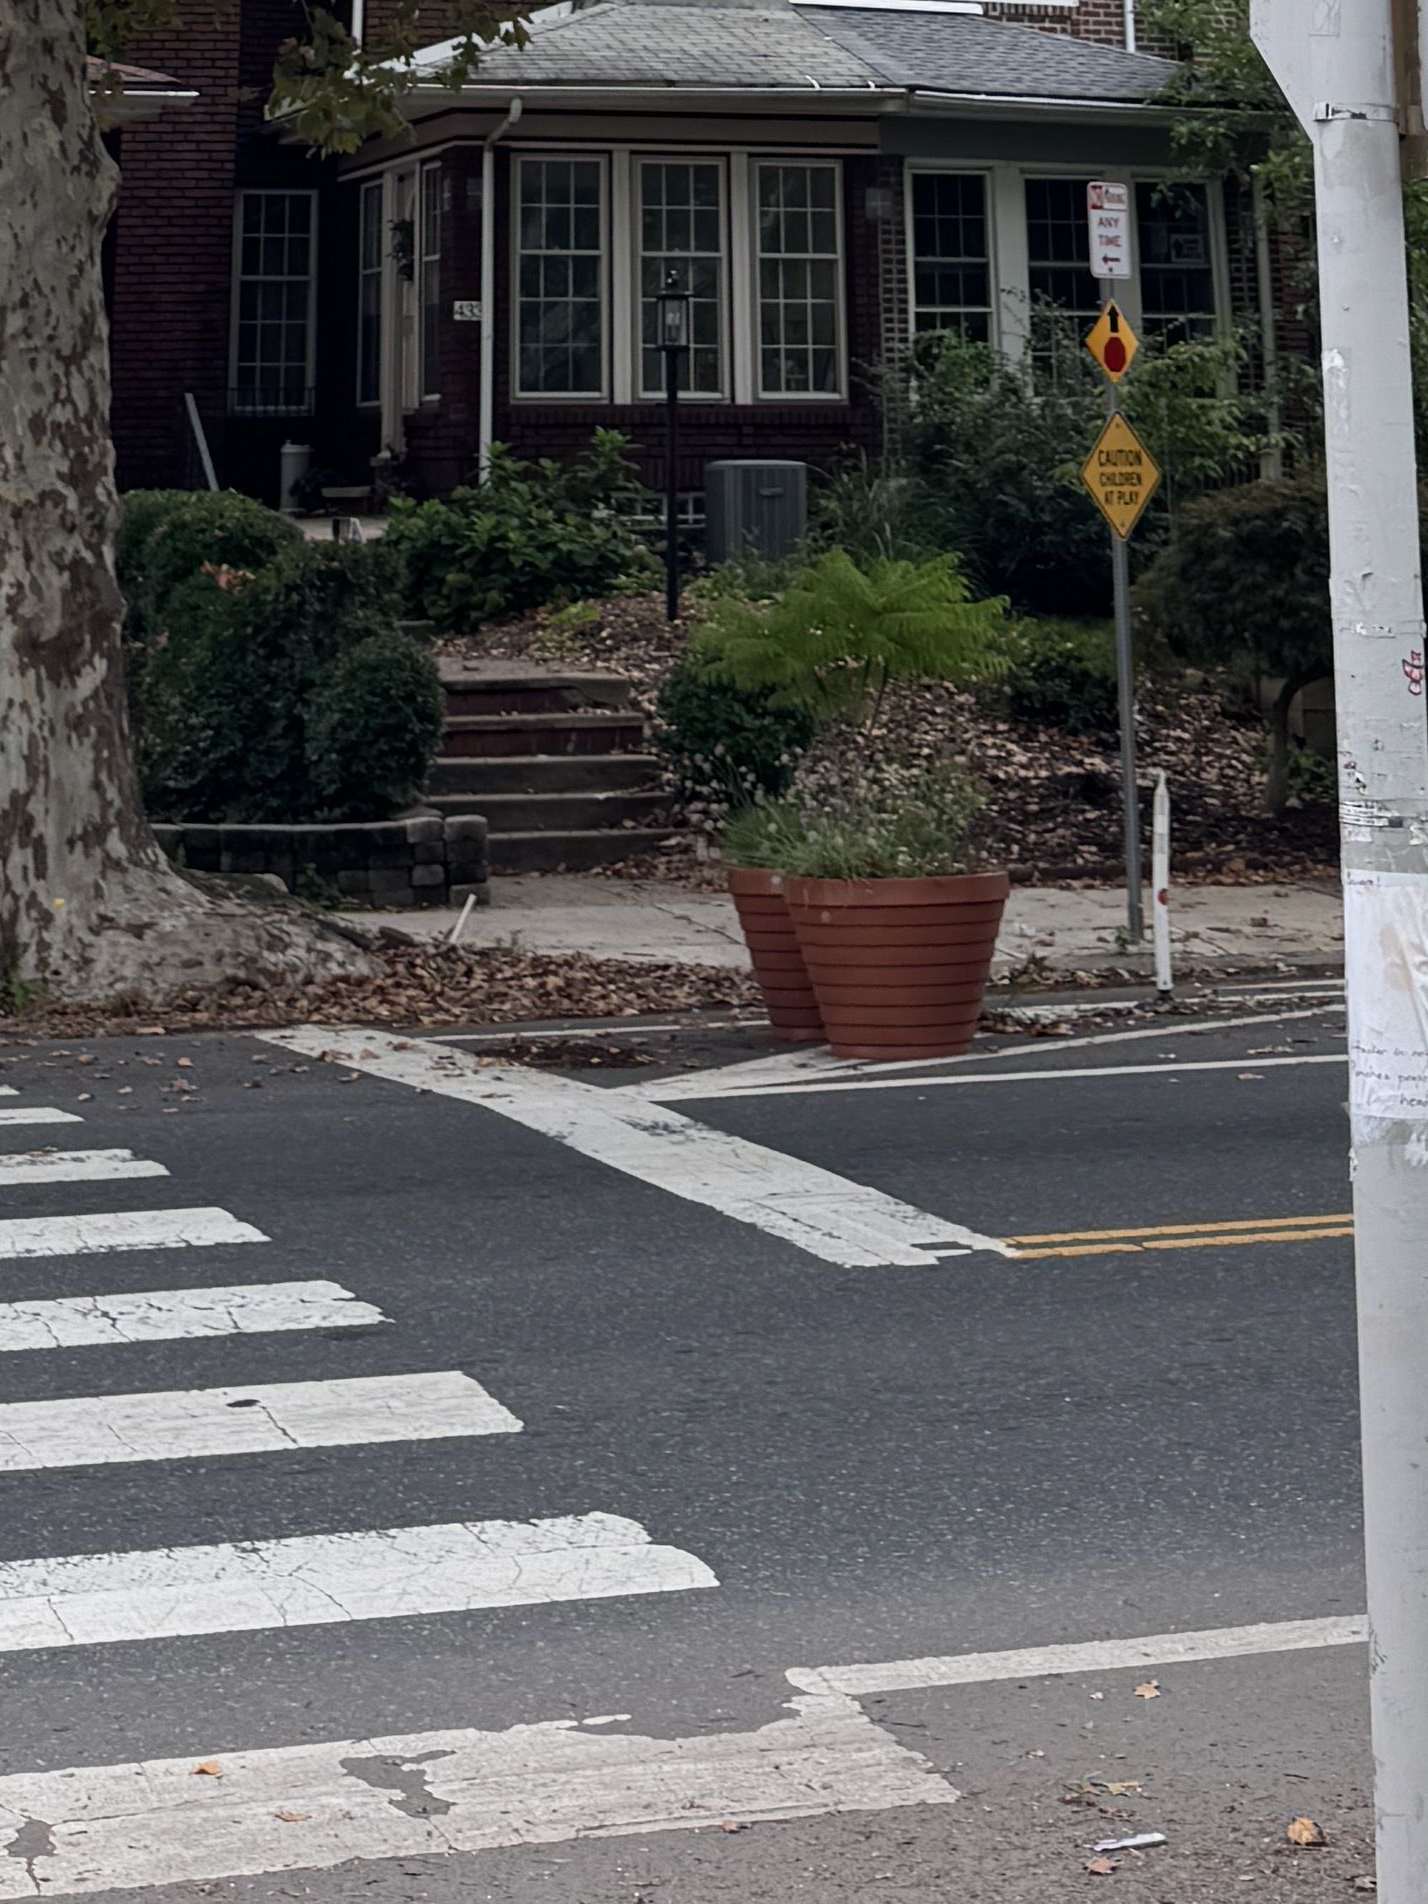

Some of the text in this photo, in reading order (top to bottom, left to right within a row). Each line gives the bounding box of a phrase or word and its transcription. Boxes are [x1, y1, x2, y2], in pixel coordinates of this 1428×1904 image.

[1098, 217, 1119, 228] ANY
[1098, 235, 1121, 247] TIME
[1098, 449, 1142, 467] CAUTION
[1100, 472, 1143, 486] CHILDREN
[1105, 491, 1139, 506] AT PLAY
